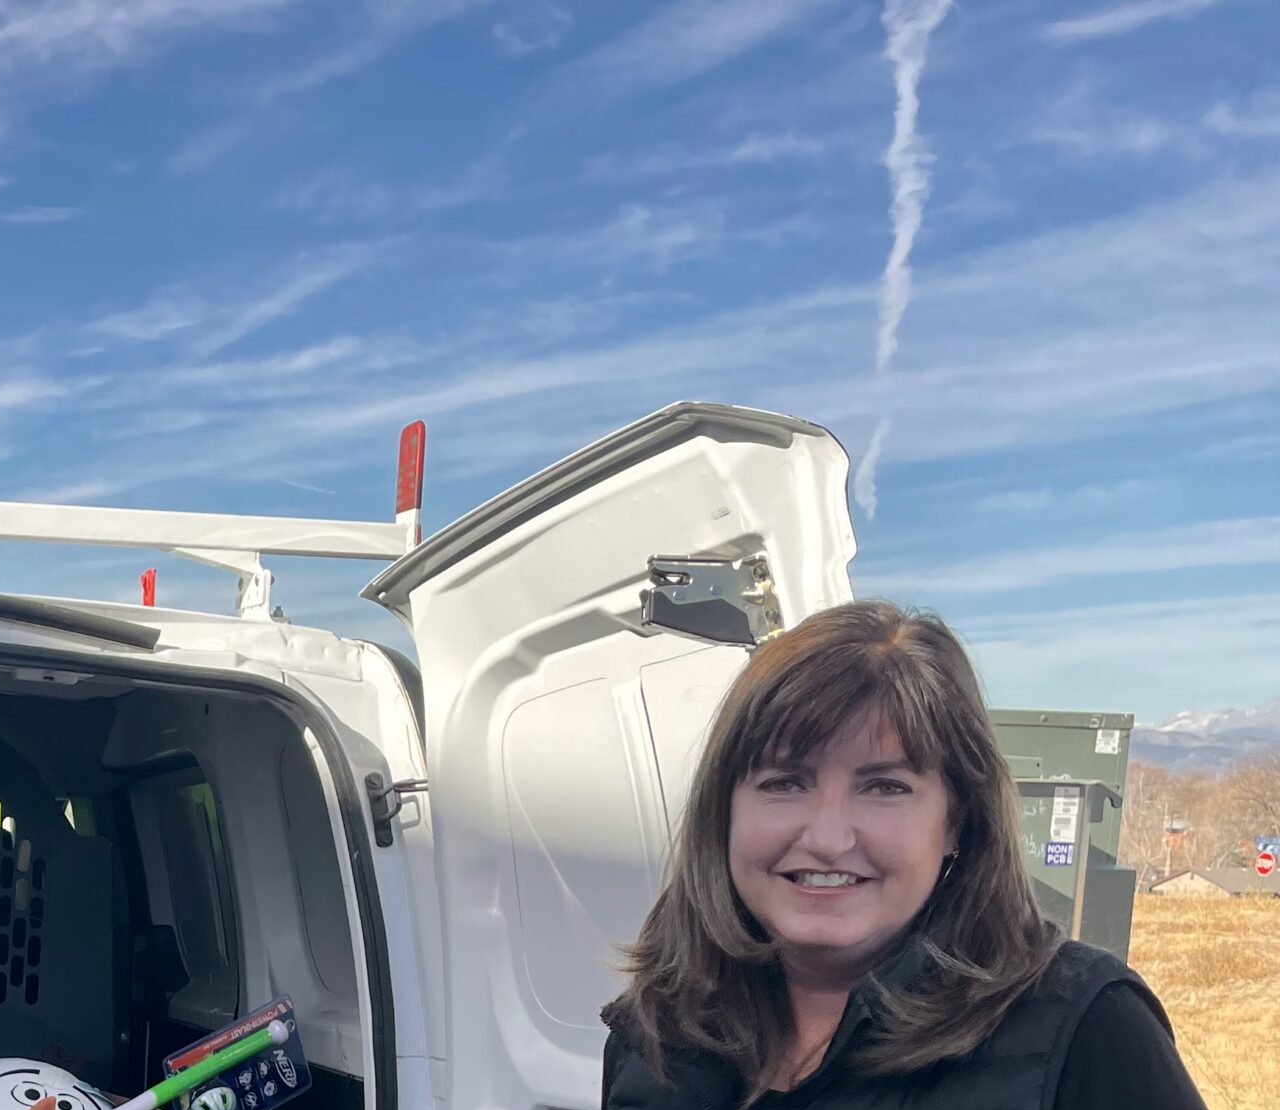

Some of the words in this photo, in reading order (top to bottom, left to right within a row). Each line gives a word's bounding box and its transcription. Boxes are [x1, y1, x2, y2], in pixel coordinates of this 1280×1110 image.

[1047, 844, 1067, 854] NON
[1047, 854, 1066, 864] PCB
[272, 1050, 298, 1088] NERF
